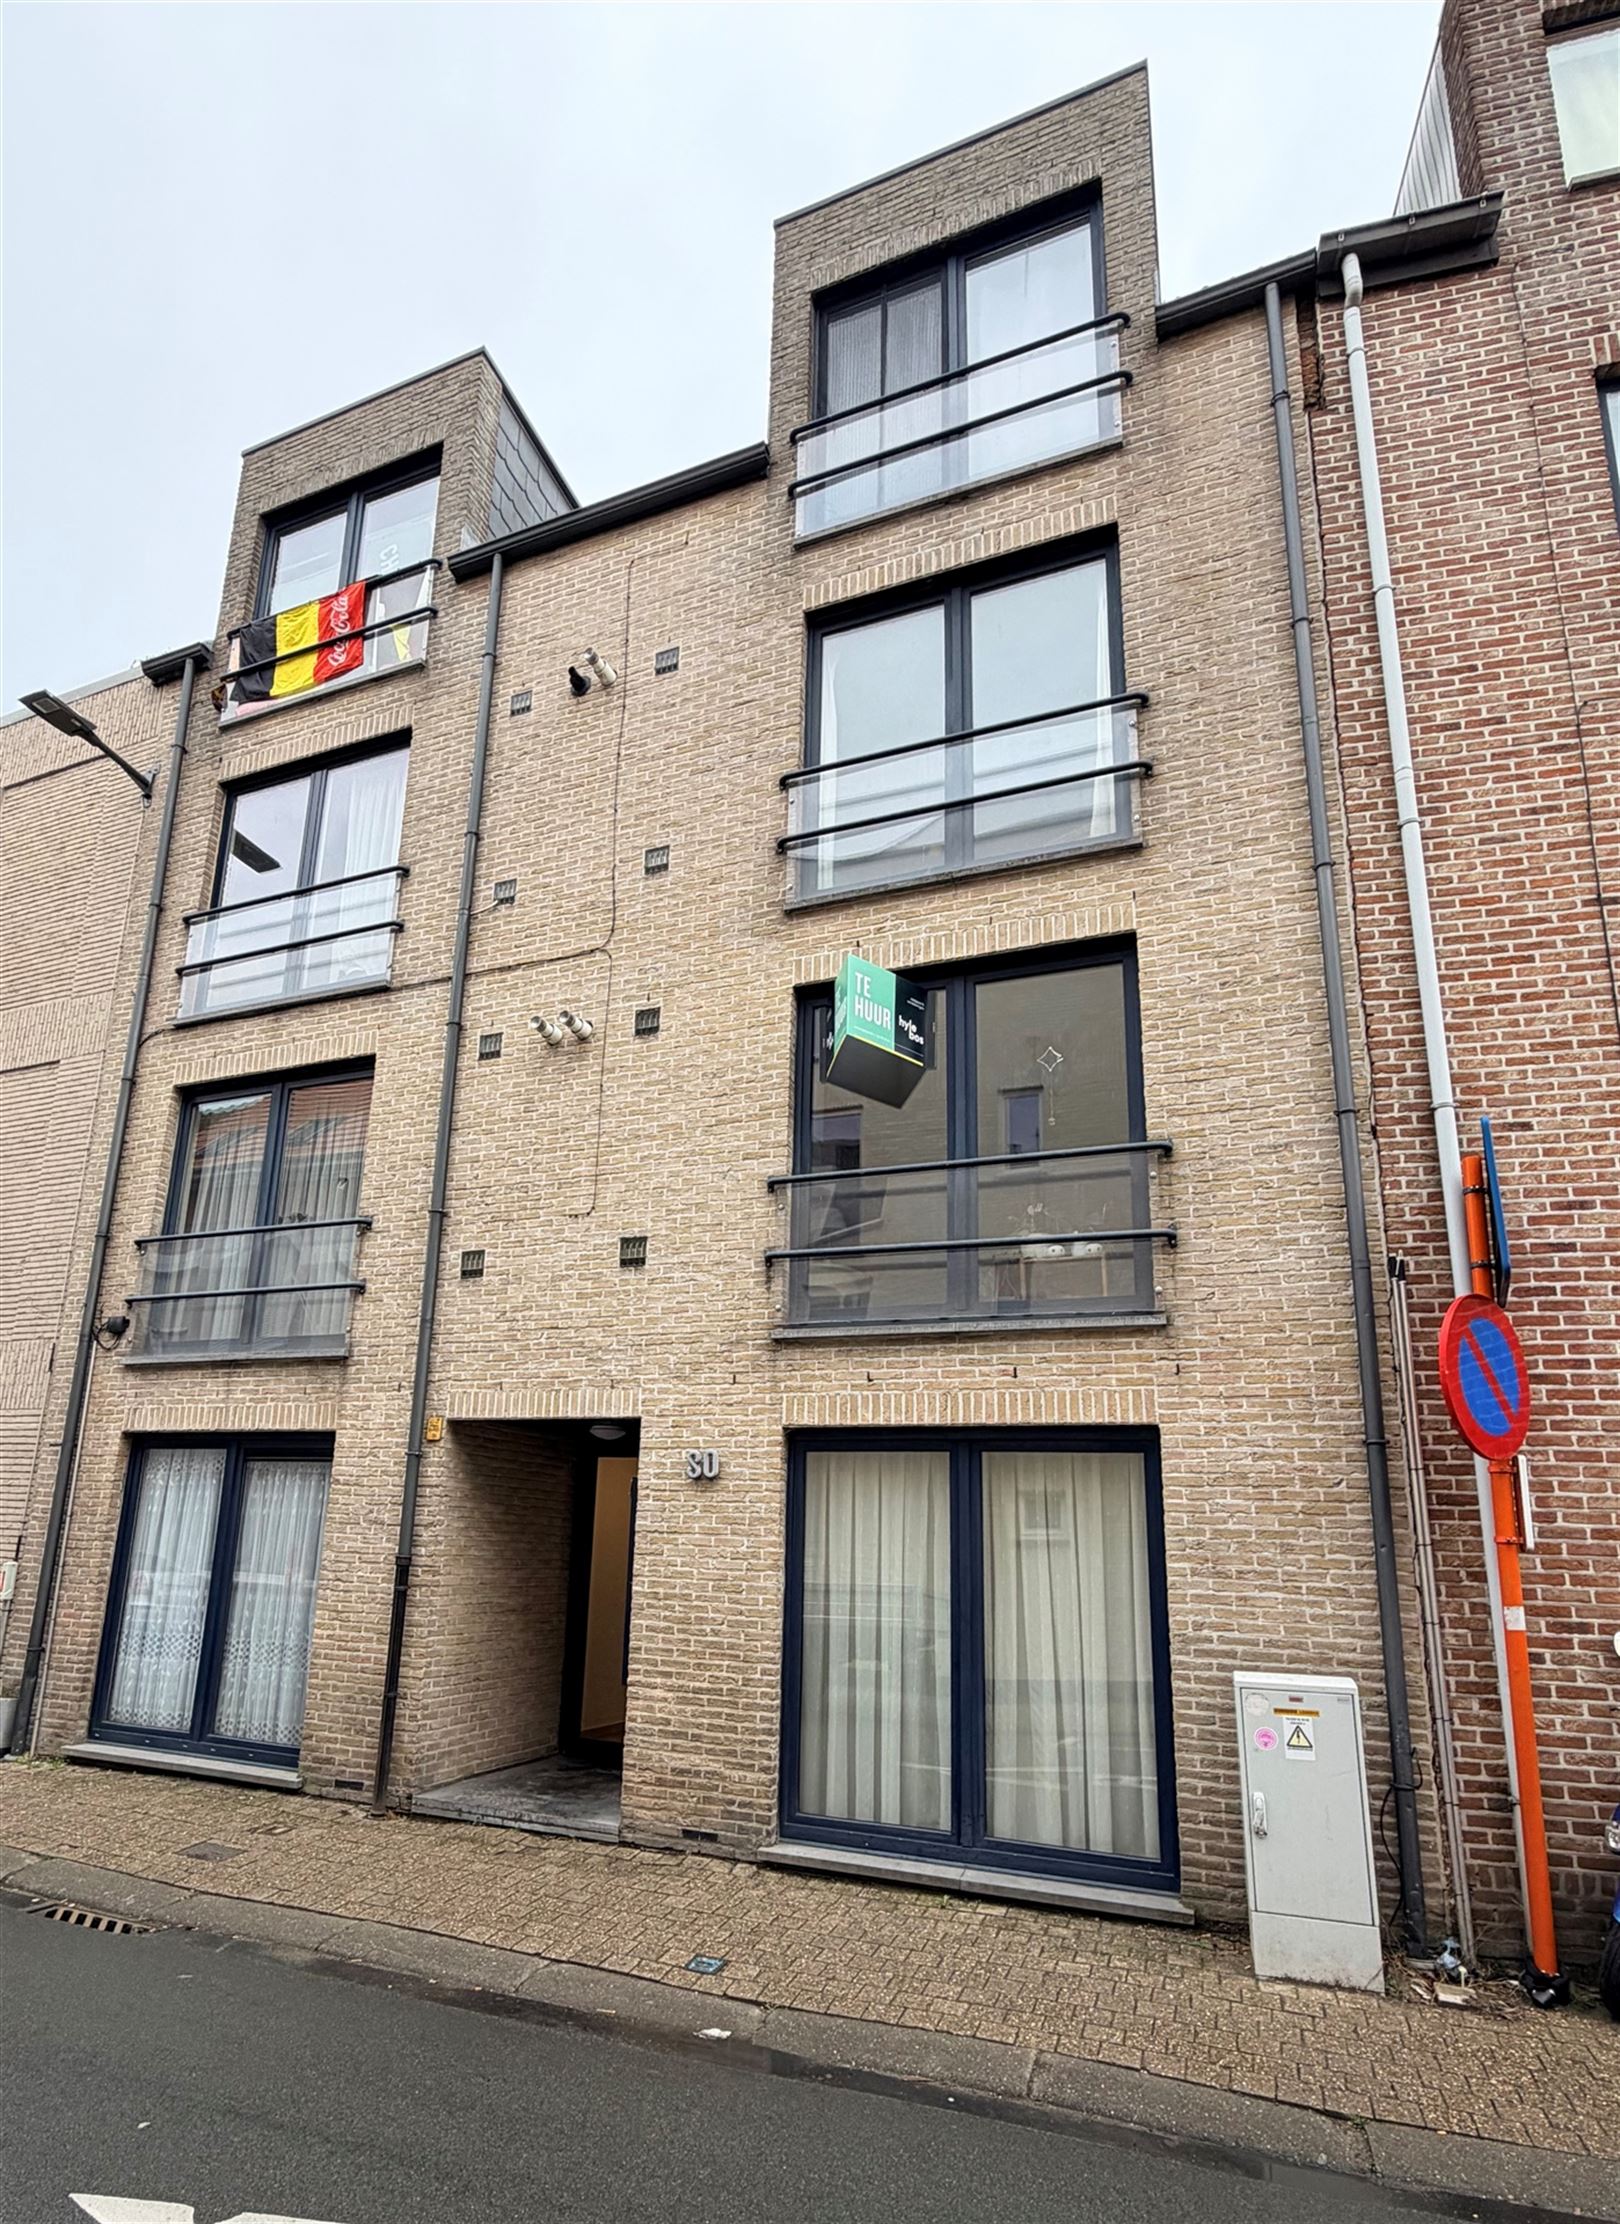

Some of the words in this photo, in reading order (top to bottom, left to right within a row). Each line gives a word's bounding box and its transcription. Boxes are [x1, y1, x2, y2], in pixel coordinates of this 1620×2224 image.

[327, 594, 352, 667] CocCola
[854, 971, 871, 998] TE
[854, 995, 891, 1030] HUUR
